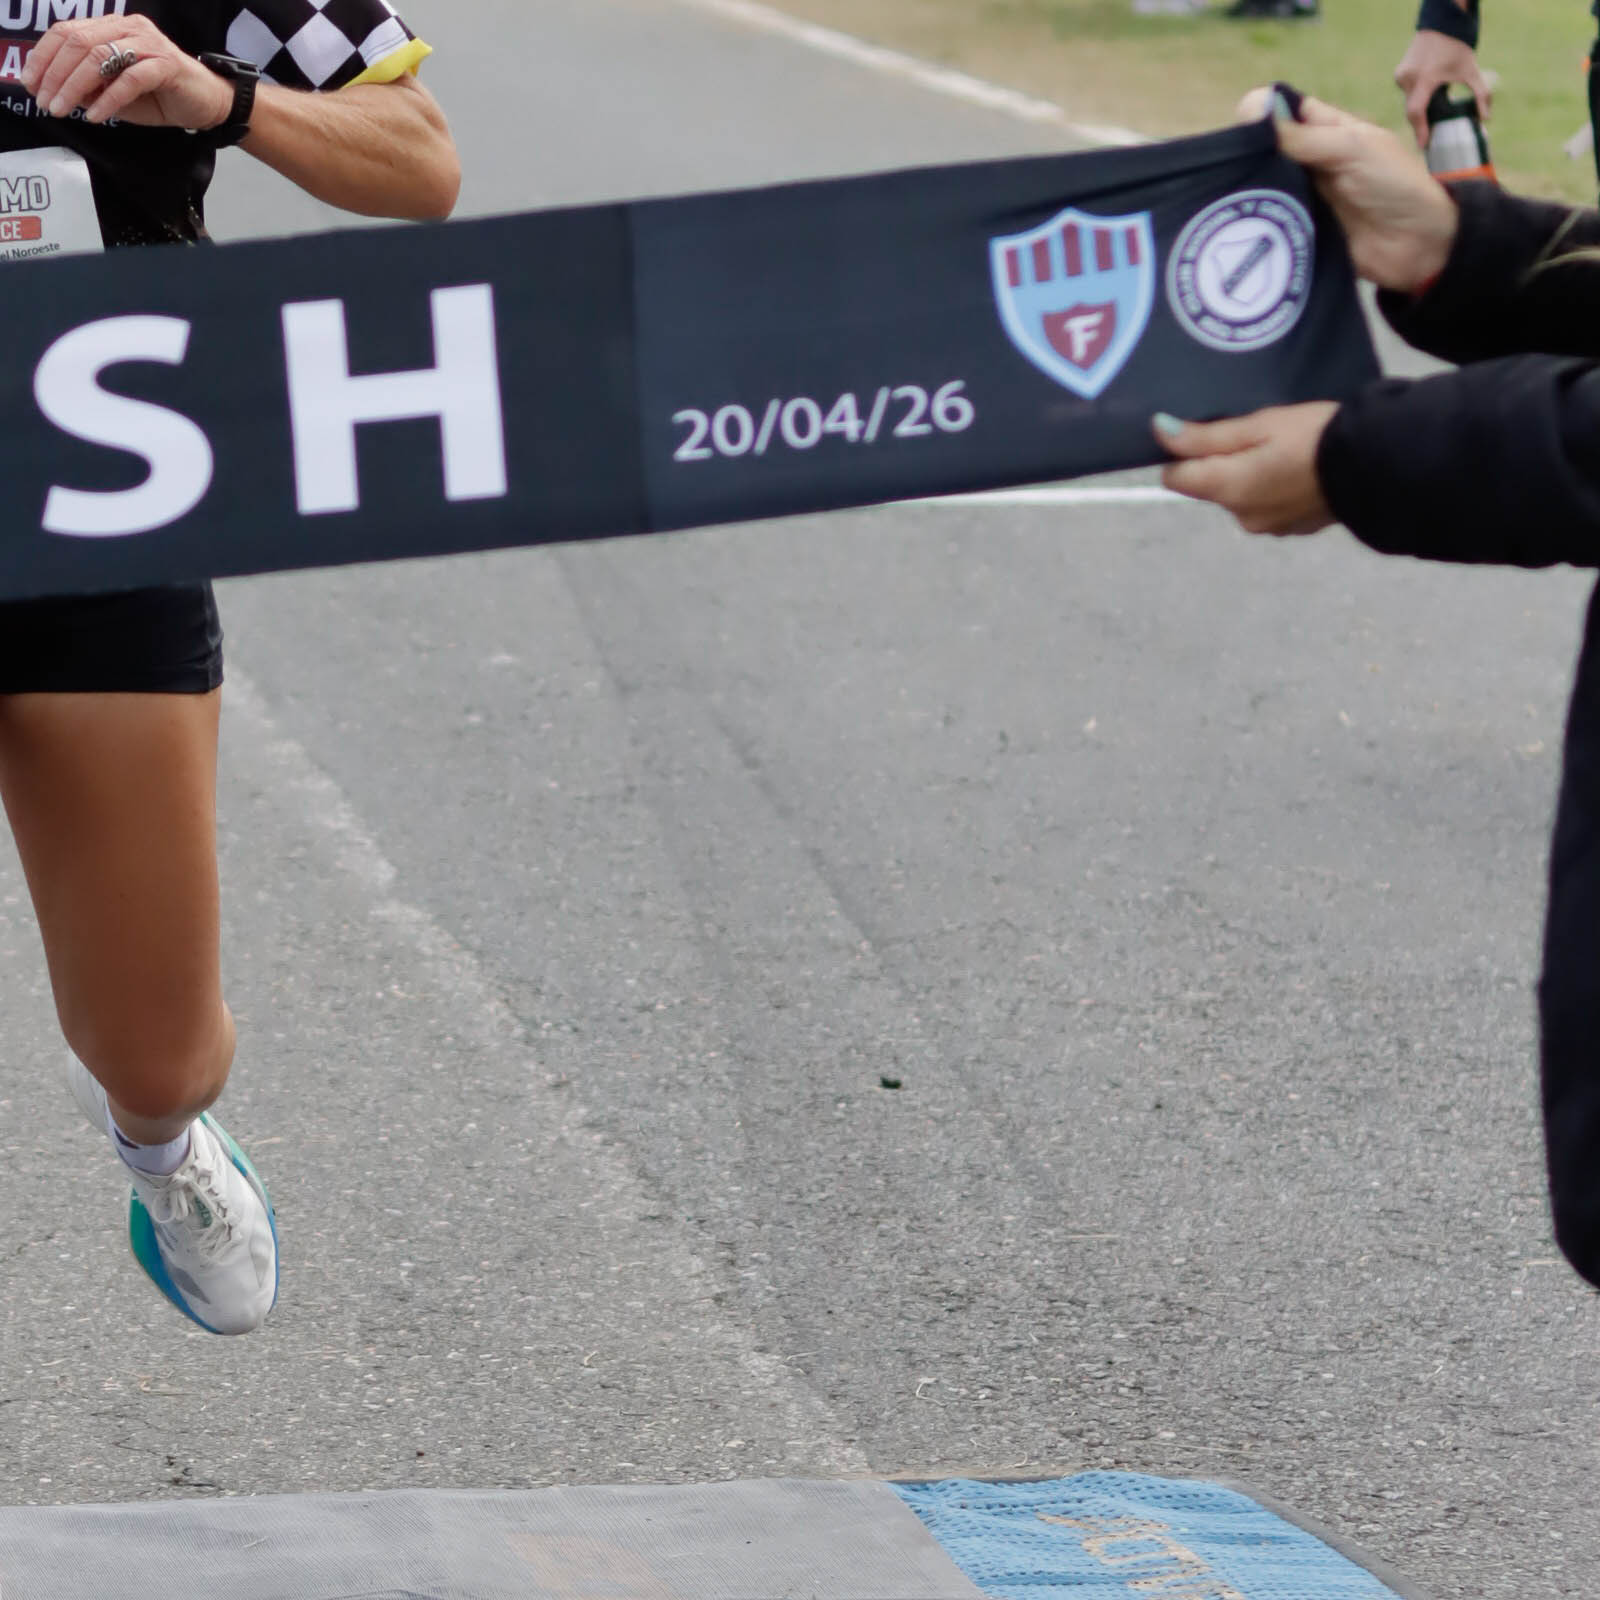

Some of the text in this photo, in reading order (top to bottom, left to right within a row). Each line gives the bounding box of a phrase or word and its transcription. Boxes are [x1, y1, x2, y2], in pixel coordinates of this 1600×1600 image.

[12, 243, 61, 259] Noroeste
[1063, 311, 1105, 361] F
[671, 379, 975, 462] 20/04/26
